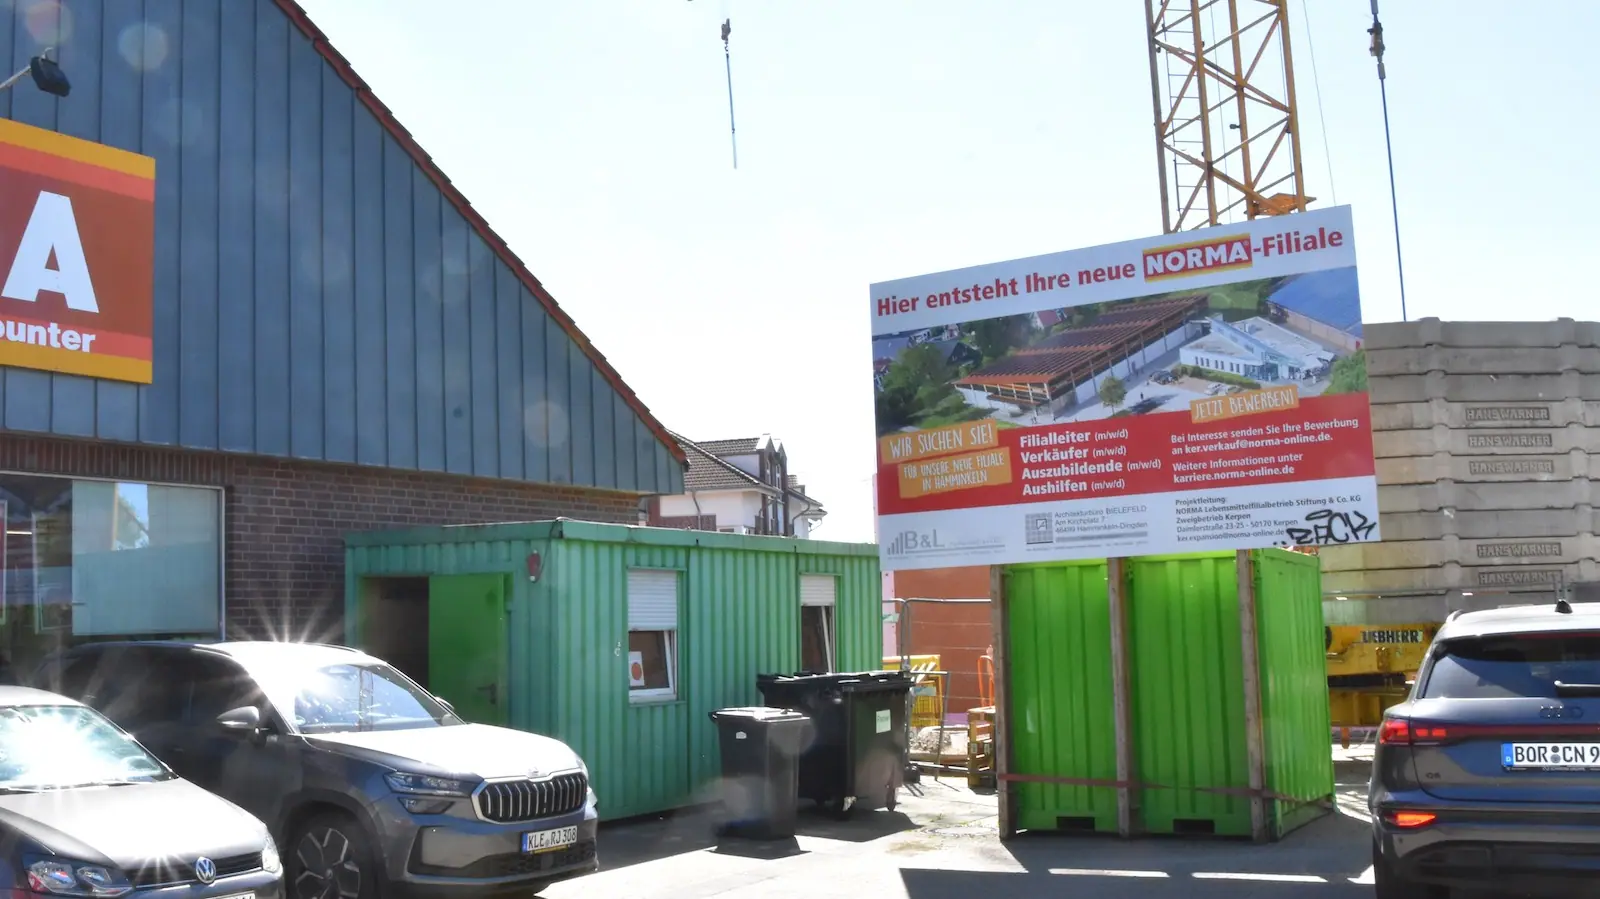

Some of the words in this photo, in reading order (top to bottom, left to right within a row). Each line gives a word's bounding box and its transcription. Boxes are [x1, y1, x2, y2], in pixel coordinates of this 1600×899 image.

[1, 190, 99, 313] A
[877, 295, 919, 316] Hier
[926, 278, 1018, 309] entsteht
[1025, 272, 1070, 293] Ihre
[1078, 263, 1136, 285] neue
[1194, 399, 1224, 419] JETZT
[1230, 389, 1295, 414] BEWERBEN!
[889, 436, 912, 458] WIR
[918, 428, 963, 453] SUCHEN
[970, 423, 993, 445] SIE!
[1020, 430, 1091, 448] Filialleiter
[1094, 429, 1129, 442] (m/w/d)
[1171, 434, 1185, 444] Bei
[1187, 430, 1229, 443] Interesse
[1231, 427, 1264, 438] senden
[1266, 425, 1280, 434] Sie
[1282, 423, 1301, 433] Ihre
[1304, 418, 1359, 431] Bewerbung
[1171, 447, 1183, 455] an
[1185, 432, 1334, 454] ker.verkauf@norma-online.de.
[1020, 446, 1089, 464] Verkäufer
[1092, 446, 1127, 458] (m/w/d)
[1172, 460, 1208, 472] Weitere
[1209, 455, 1275, 469] Informationen
[1277, 452, 1303, 463] unter
[903, 464, 917, 479] FÜR
[920, 461, 949, 477] UNSERE
[952, 457, 972, 472] NEUE
[976, 452, 1005, 468] FILIALE
[1022, 459, 1123, 480] Auszubildende
[1126, 458, 1162, 472] (m/w/d)
[1173, 465, 1295, 484] karriere.norma-online.de
[922, 476, 931, 492] IN
[935, 470, 988, 489] HAMMINKELN
[1022, 479, 1088, 496] Aushilfen
[1091, 479, 1125, 491] (m/w/d)
[1106, 505, 1147, 515] BIELEFELD
[1176, 506, 1203, 515] NORMA
[1295, 498, 1327, 506] Stiftung
[1176, 514, 1224, 524] Zweigbetrieb
[1225, 513, 1251, 521] Kerpen
[1273, 519, 1298, 527] Kerpen
[1362, 629, 1419, 643] LIEBHERR
[1515, 746, 1548, 763] BOR
[1562, 746, 1586, 763] CN
[528, 832, 545, 849] KLE
